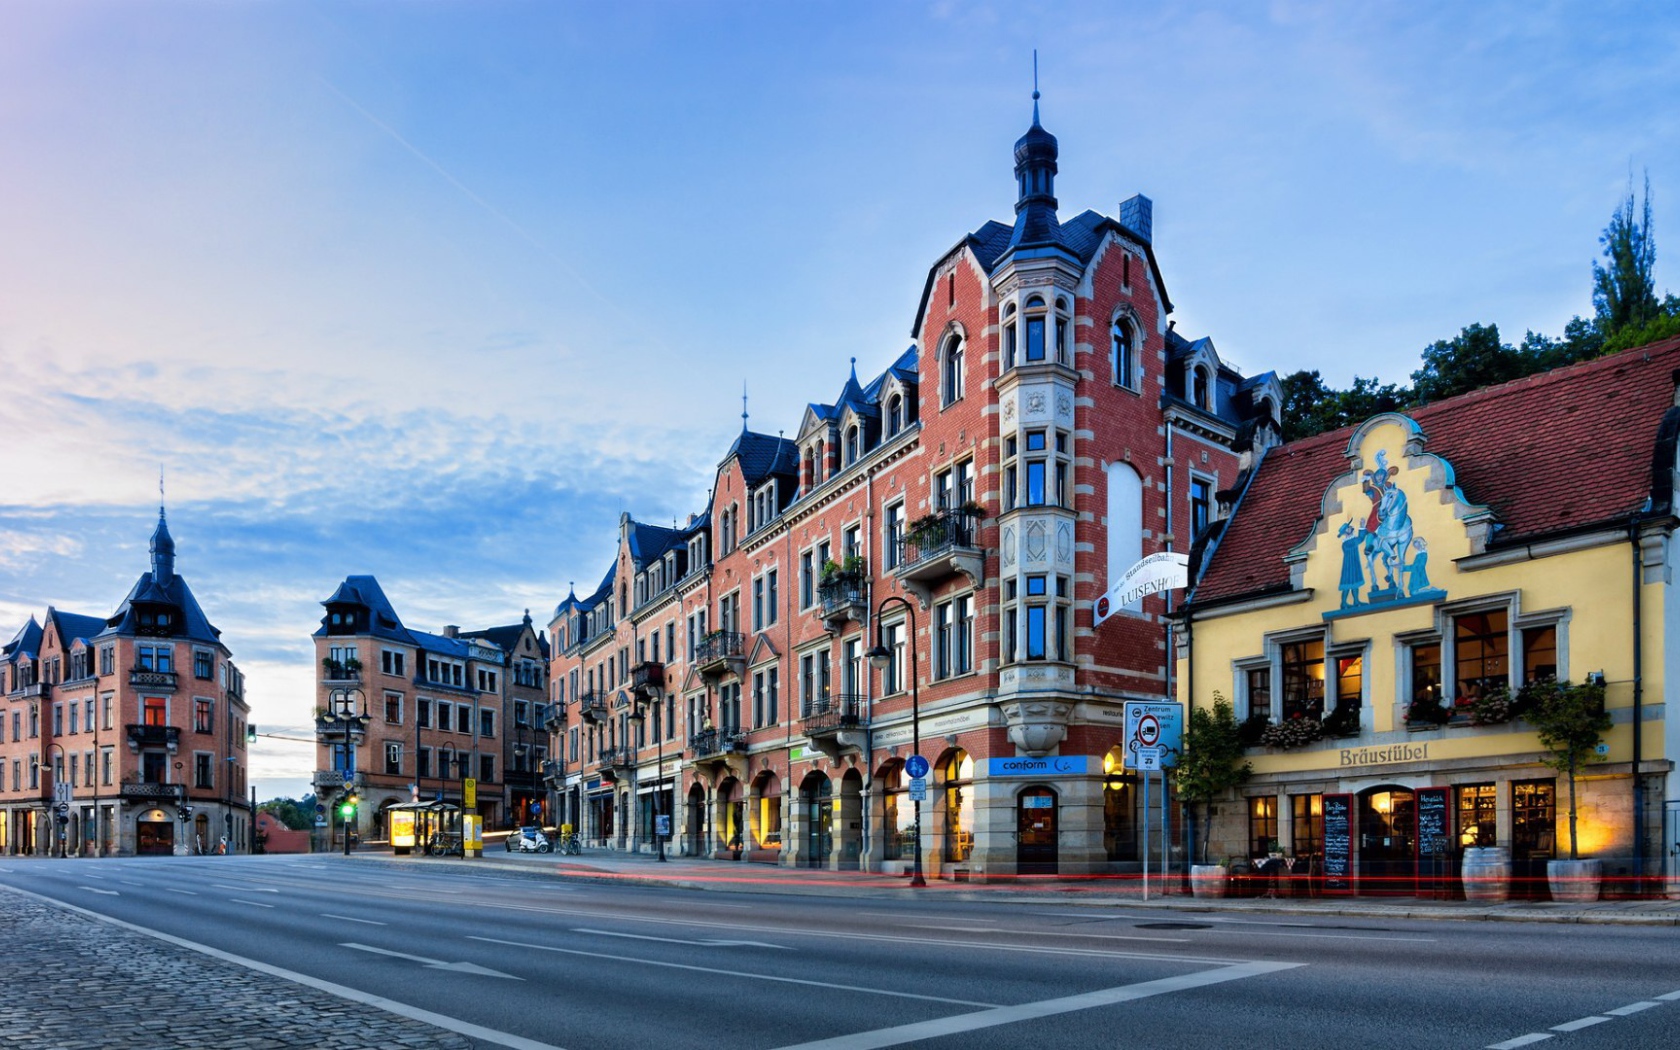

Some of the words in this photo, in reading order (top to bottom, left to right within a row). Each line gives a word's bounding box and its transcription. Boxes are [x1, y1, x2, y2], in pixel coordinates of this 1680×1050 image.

[1121, 575, 1179, 607] LUISENHOF
[1144, 705, 1171, 713] Zentrum
[1340, 743, 1429, 766] Bräustübel
[1003, 759, 1047, 771] conform
